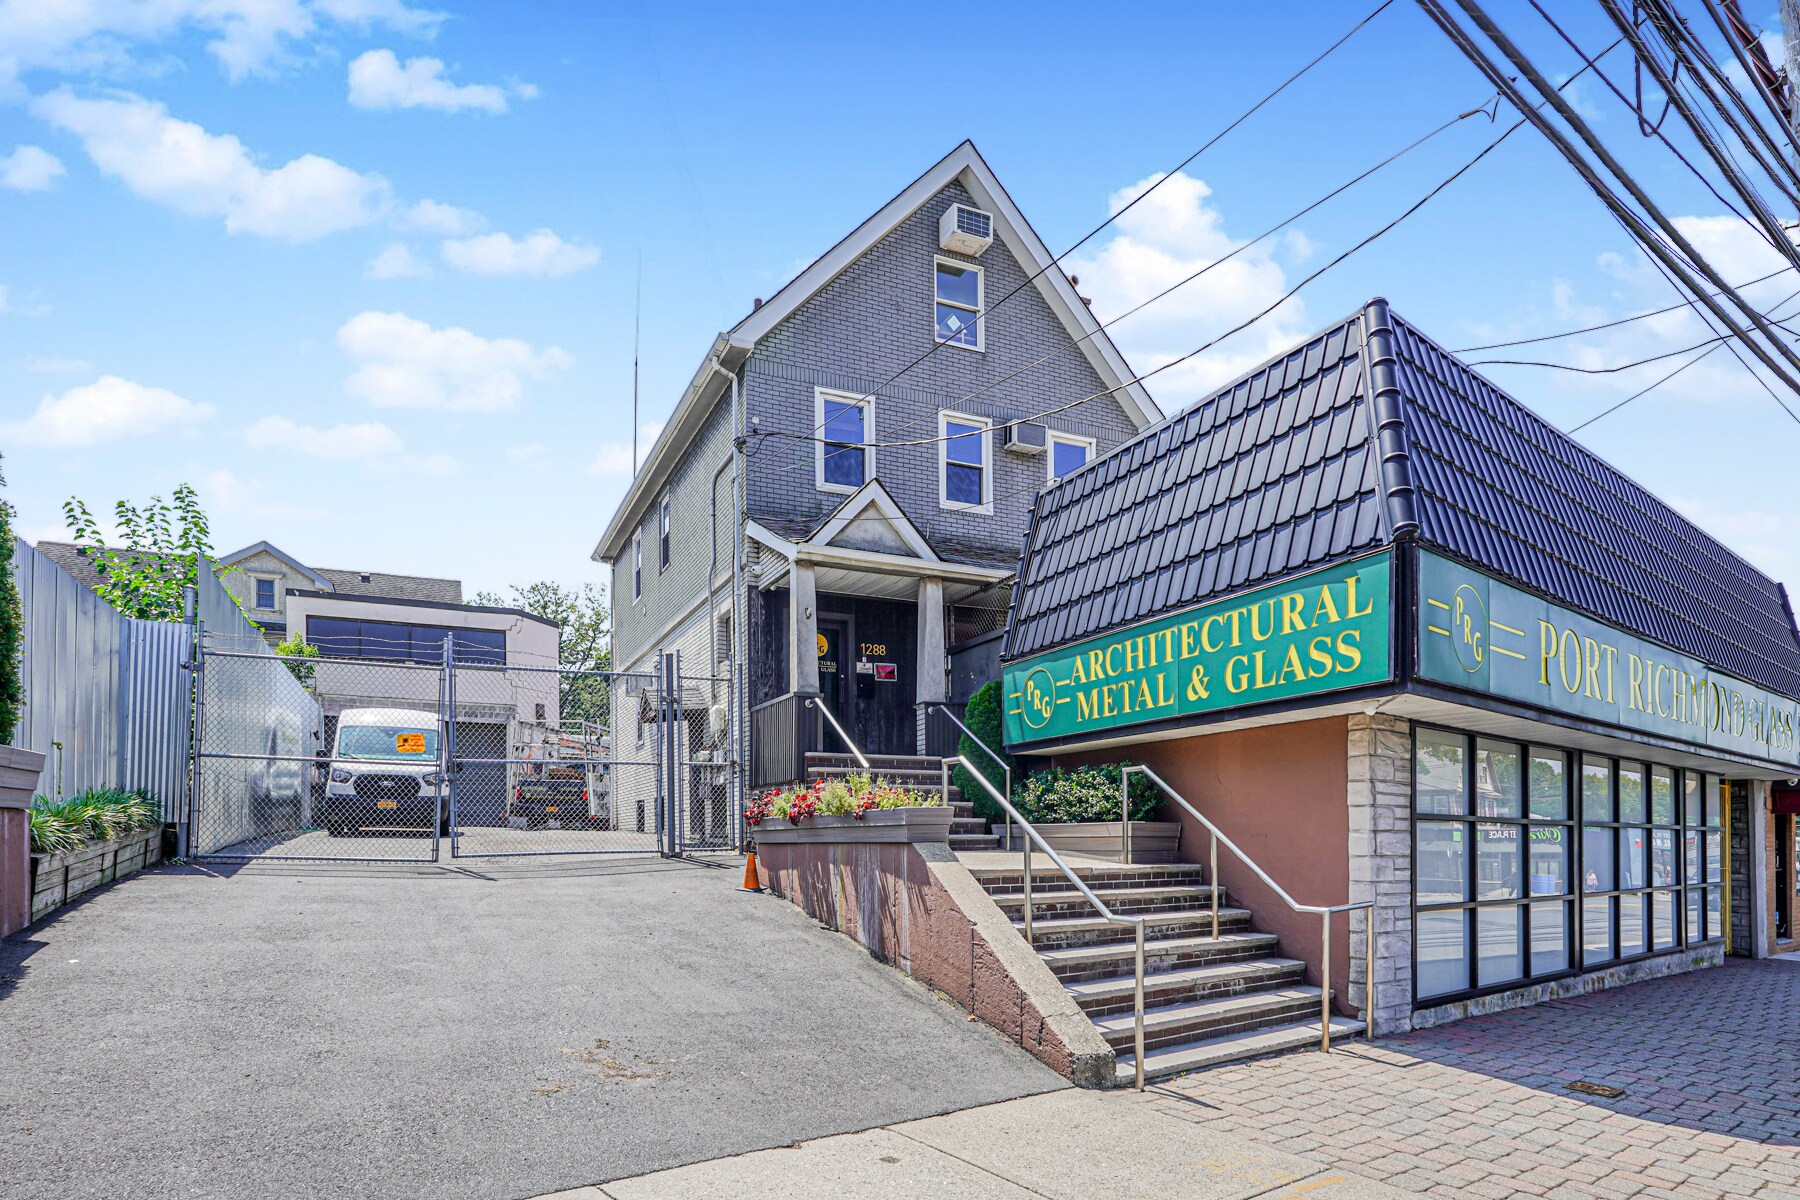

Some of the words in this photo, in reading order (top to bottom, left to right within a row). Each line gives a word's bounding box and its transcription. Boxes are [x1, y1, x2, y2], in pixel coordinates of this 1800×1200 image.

[860, 642, 886, 656] 1288
[1070, 575, 1373, 686] ARCHITECTURAL
[1456, 595, 1483, 662] PRG
[1027, 680, 1051, 719] PRG
[1076, 673, 1175, 722] METAL
[1186, 664, 1211, 702] &
[1225, 630, 1363, 694] GLASS
[1538, 618, 1619, 704] PORT
[1627, 652, 1746, 738] RICHMOND
[1749, 698, 1793, 752] GLASS
